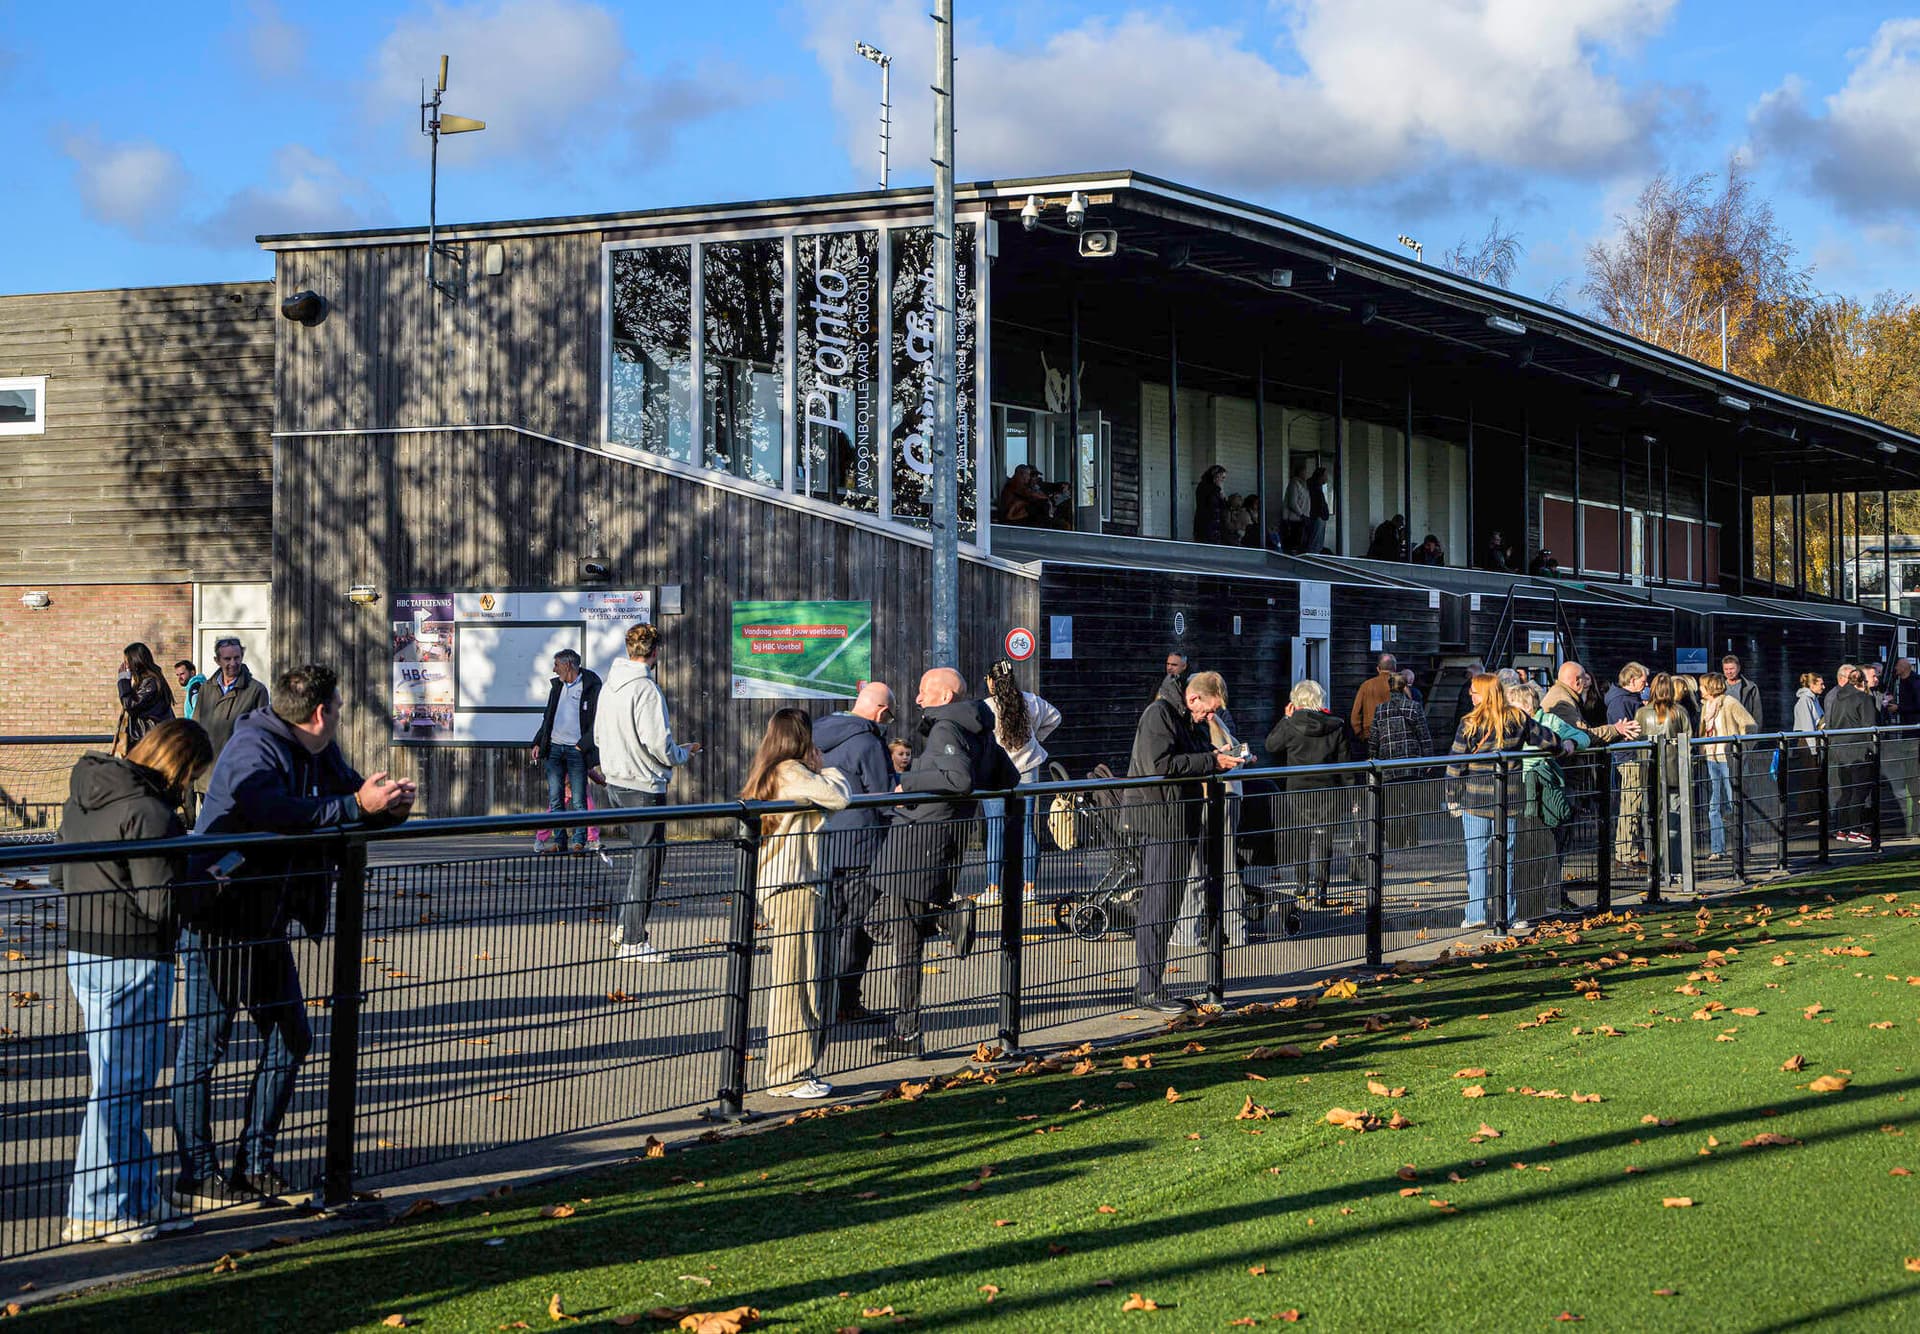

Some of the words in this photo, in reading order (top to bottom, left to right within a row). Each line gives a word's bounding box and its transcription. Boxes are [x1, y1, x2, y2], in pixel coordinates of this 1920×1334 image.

[857, 255, 870, 335] CRUQUIUS
[956, 264, 967, 300] Coffee
[805, 268, 849, 430] Pronto
[956, 351, 967, 384] Shoes
[857, 342, 870, 488] WOONBOULEVARD
[396, 599, 410, 608] HBC
[411, 599, 452, 608] TAFELTENNIS
[744, 627, 772, 637] Vandaag
[773, 627, 791, 635] wordt
[792, 627, 808, 637] jouw
[809, 627, 846, 636] voetbaldag
[753, 642, 762, 651] bij
[776, 642, 801, 651] Voetbal
[401, 668, 430, 681] HBC
